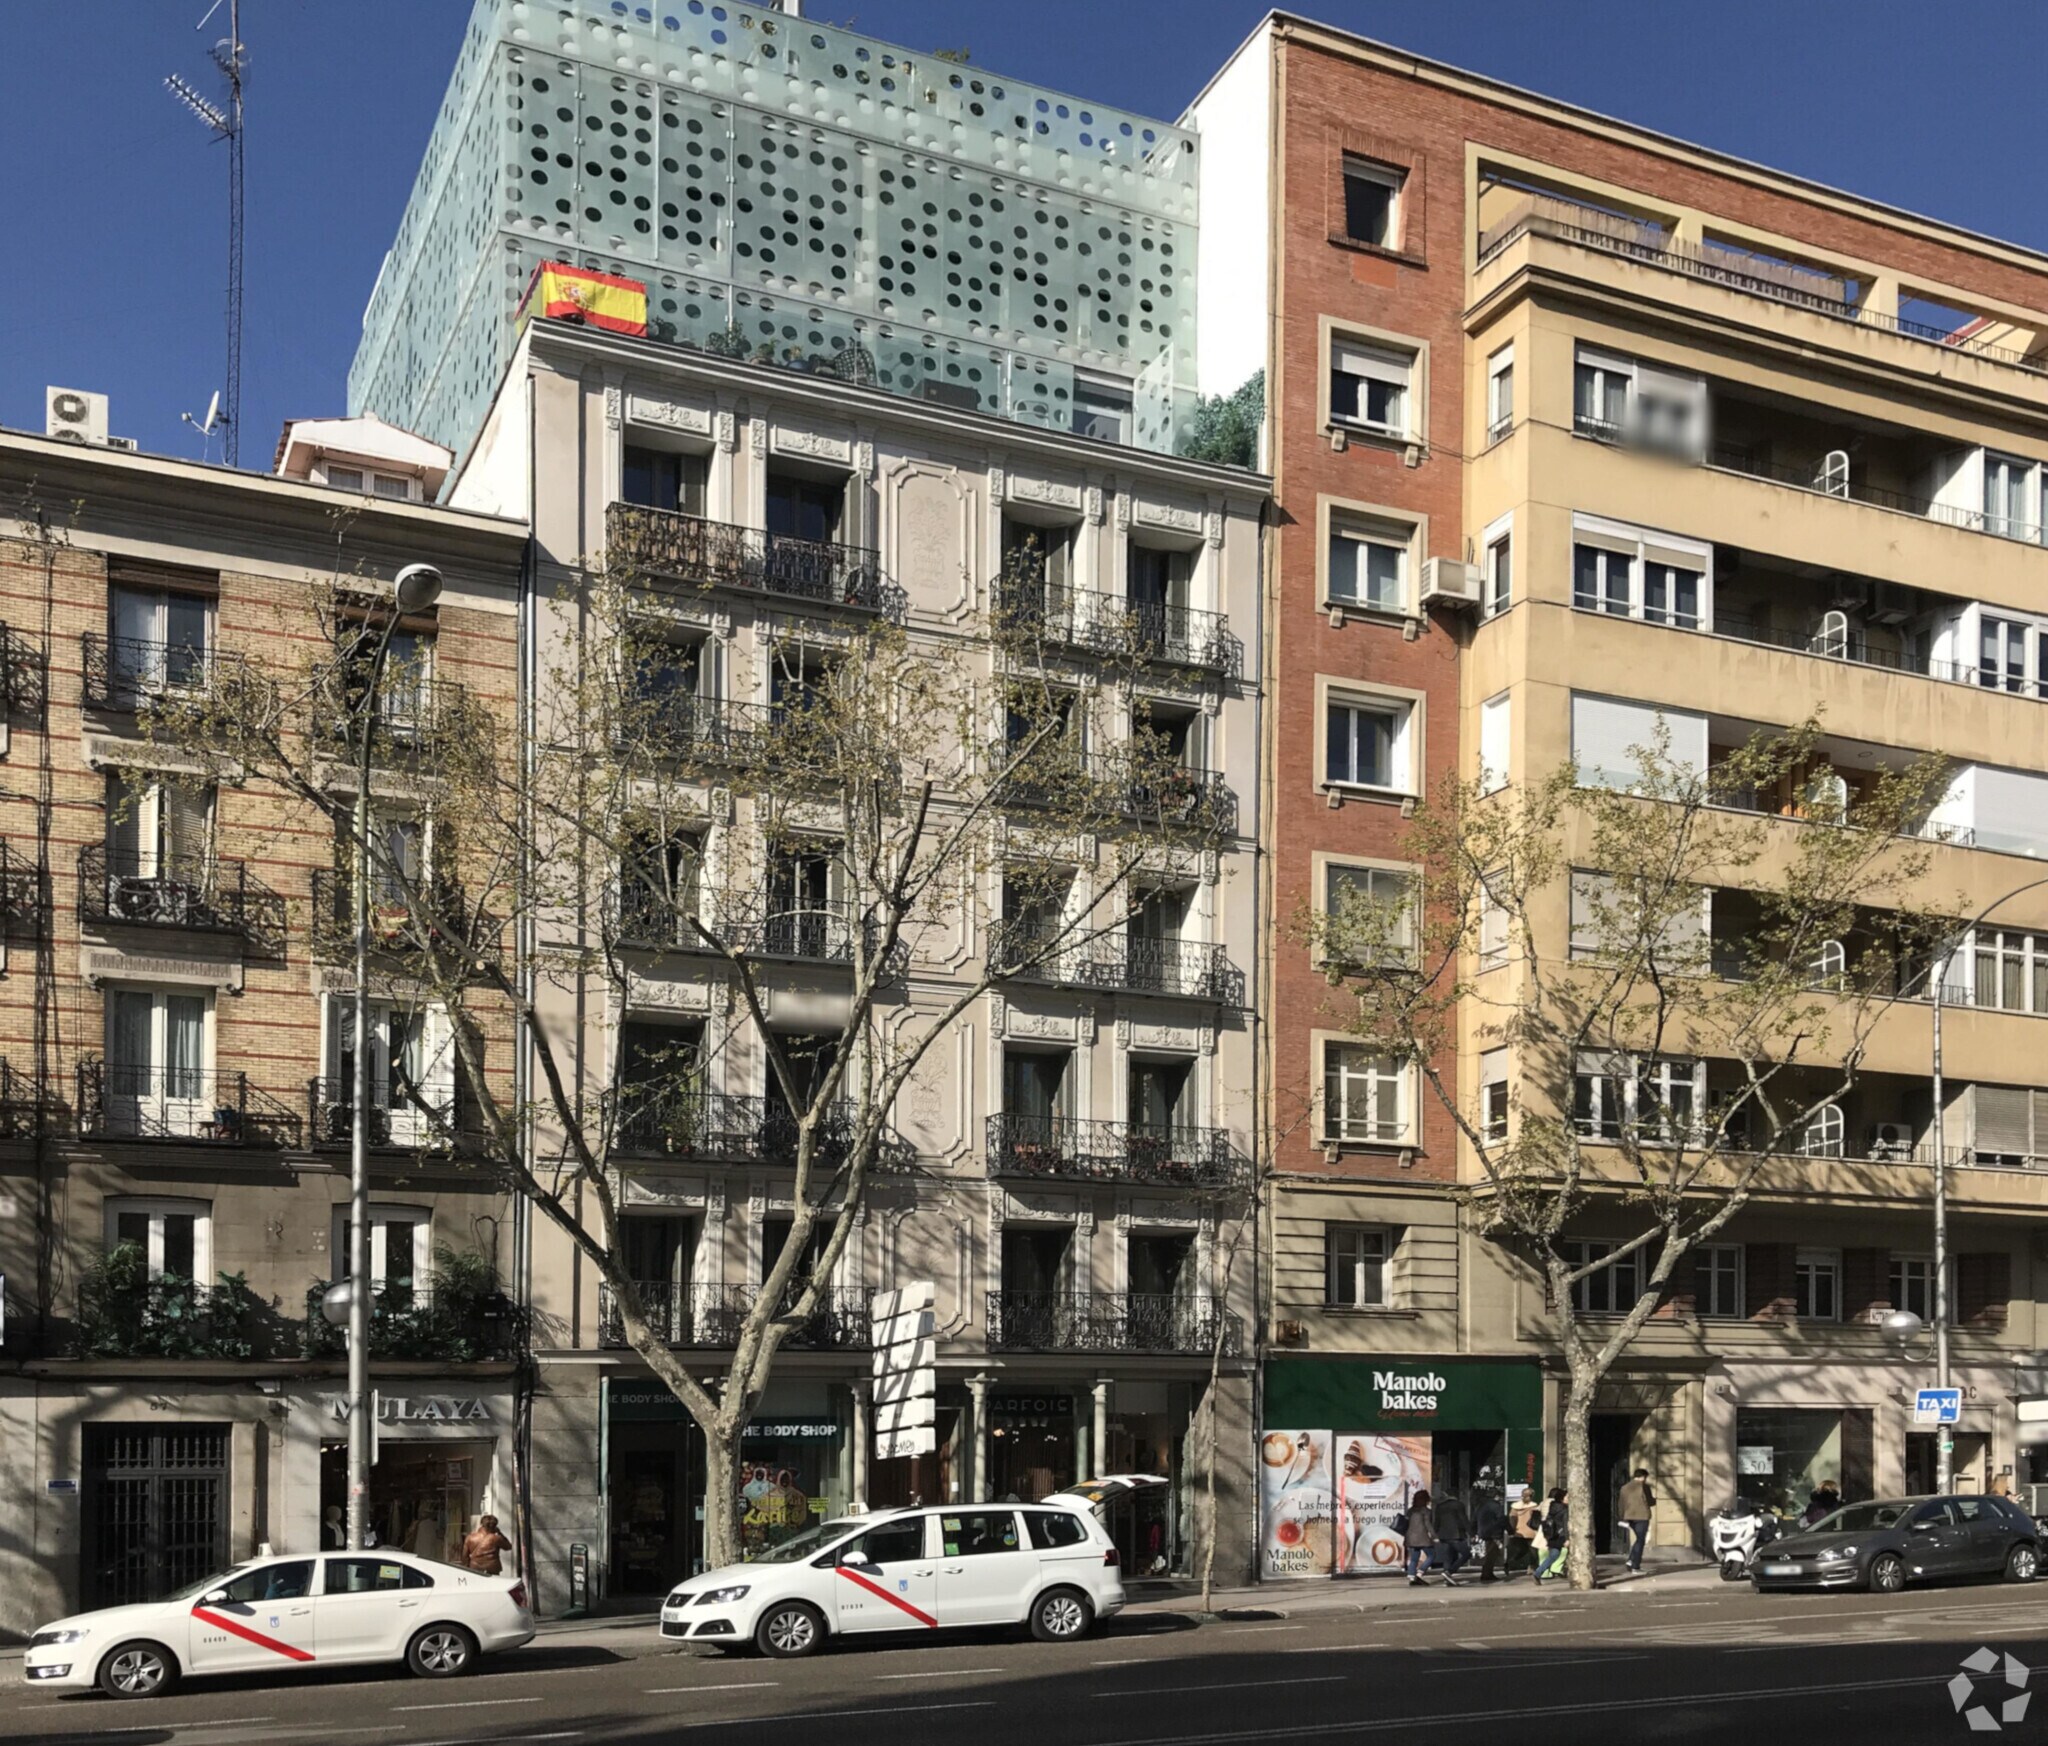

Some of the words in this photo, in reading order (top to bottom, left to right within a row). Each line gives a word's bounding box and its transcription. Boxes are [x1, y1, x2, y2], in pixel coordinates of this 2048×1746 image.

[1372, 1371, 1446, 1391] Manolo
[622, 1394, 651, 1403] BODY
[653, 1394, 680, 1403] SHO
[1382, 1390, 1437, 1410] bakes
[1920, 1398, 1956, 1409] TAXI
[742, 1426, 760, 1436] HE
[764, 1426, 799, 1436] BODY
[801, 1425, 838, 1436] SHOP
[1298, 1501, 1315, 1510] Las
[1353, 1514, 1376, 1525] fuego
[1379, 1514, 1394, 1524] lent
[1266, 1549, 1314, 1562] Manolo
[1272, 1561, 1309, 1572] bakes
